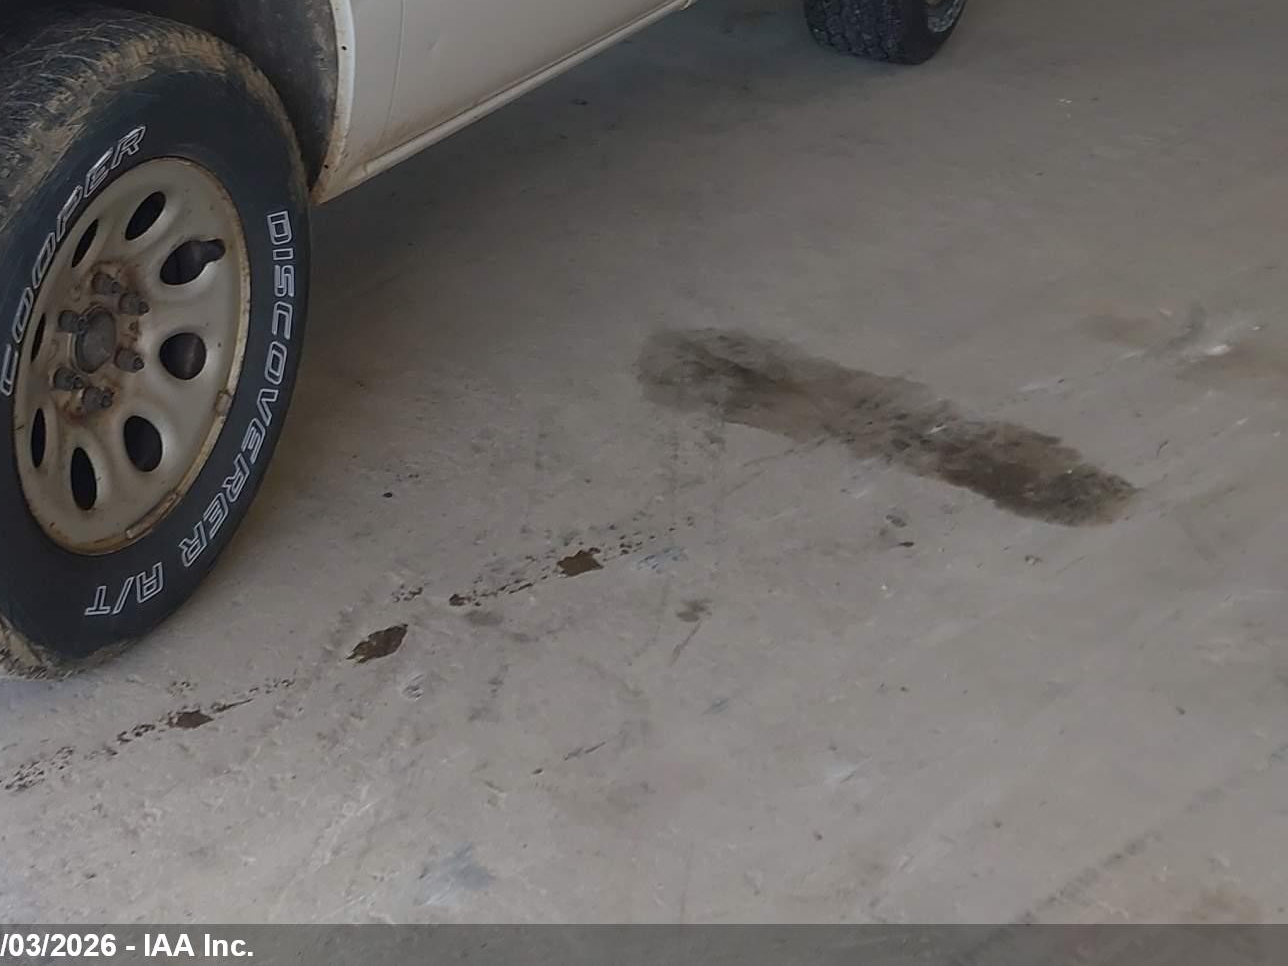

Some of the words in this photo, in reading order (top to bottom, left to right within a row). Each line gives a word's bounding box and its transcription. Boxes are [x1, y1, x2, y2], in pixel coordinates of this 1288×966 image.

[0, 125, 147, 397] COOPER
[178, 209, 297, 569] DISCOVERER
[85, 561, 165, 617] A/T
